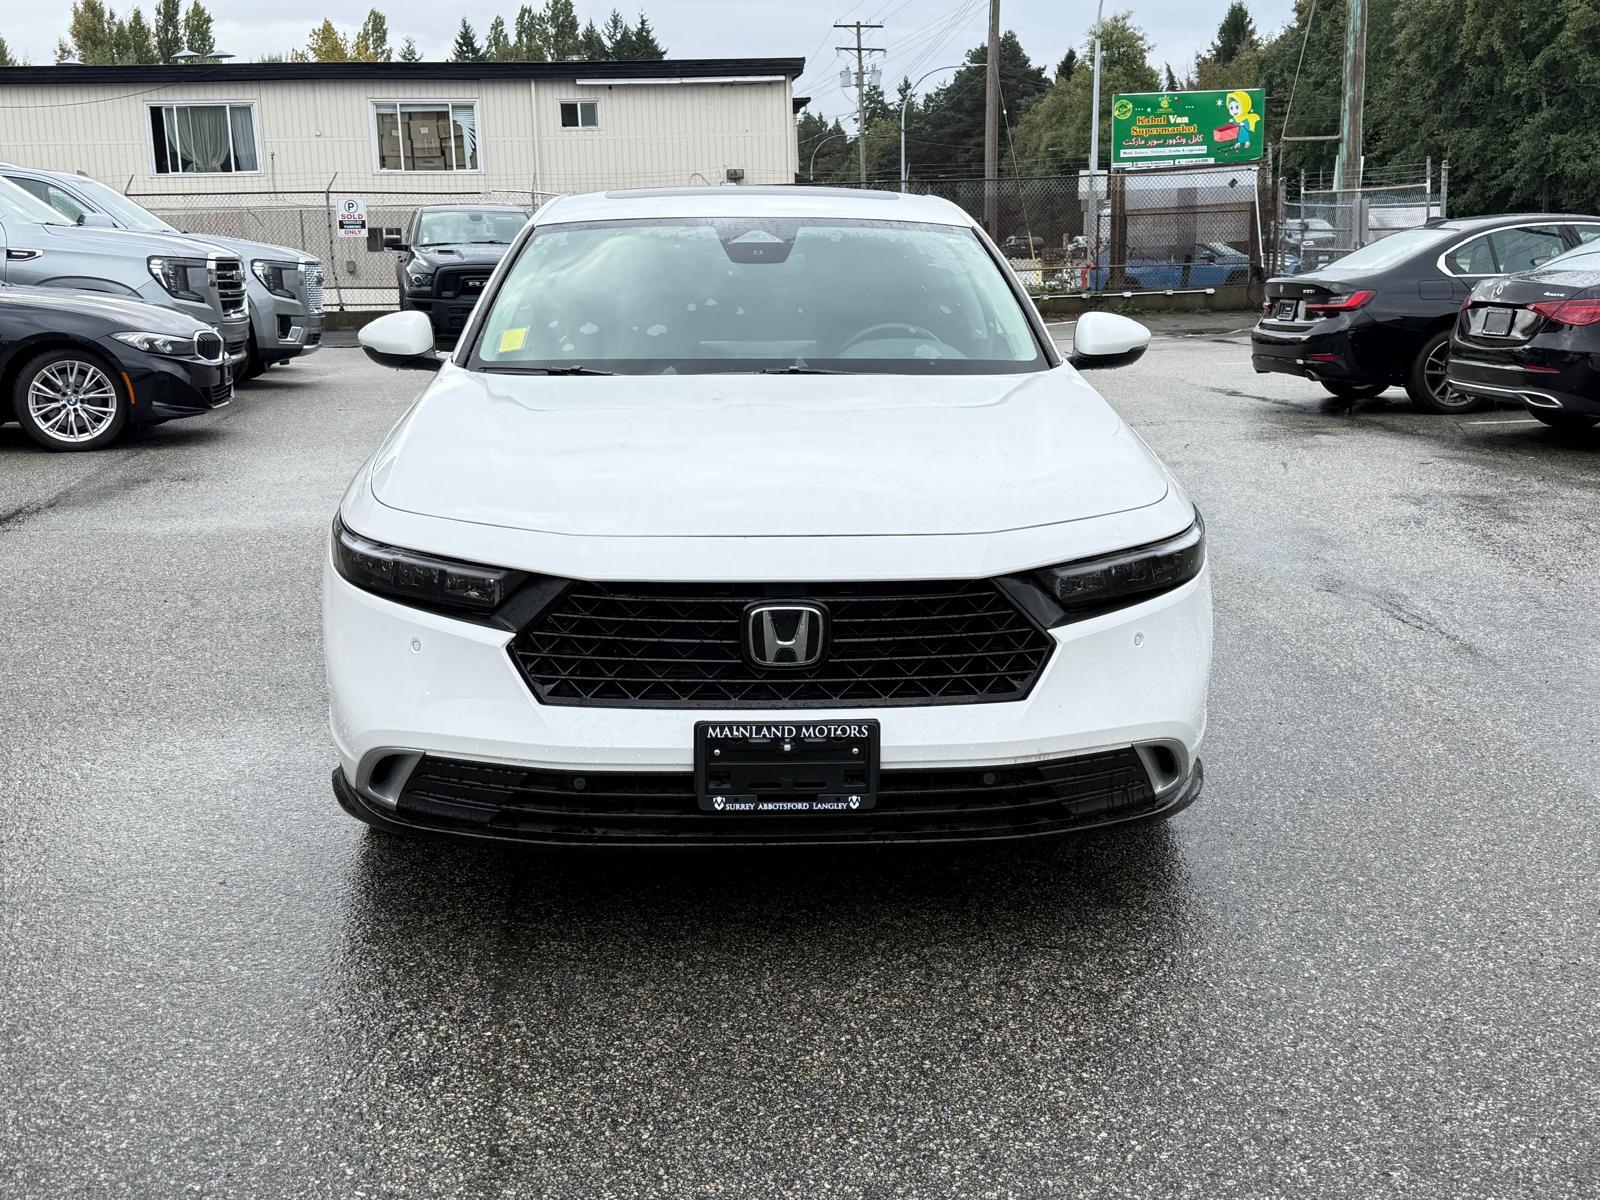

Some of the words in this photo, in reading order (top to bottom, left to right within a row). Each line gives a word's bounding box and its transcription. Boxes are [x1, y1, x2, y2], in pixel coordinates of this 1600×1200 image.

[1168, 115, 1189, 123] Van
[1131, 124, 1197, 136] Supermarket
[1122, 137, 1145, 145] مارکت
[347, 202, 354, 211] P
[707, 726, 796, 738] MAINLAND
[801, 725, 868, 738] MOTORS
